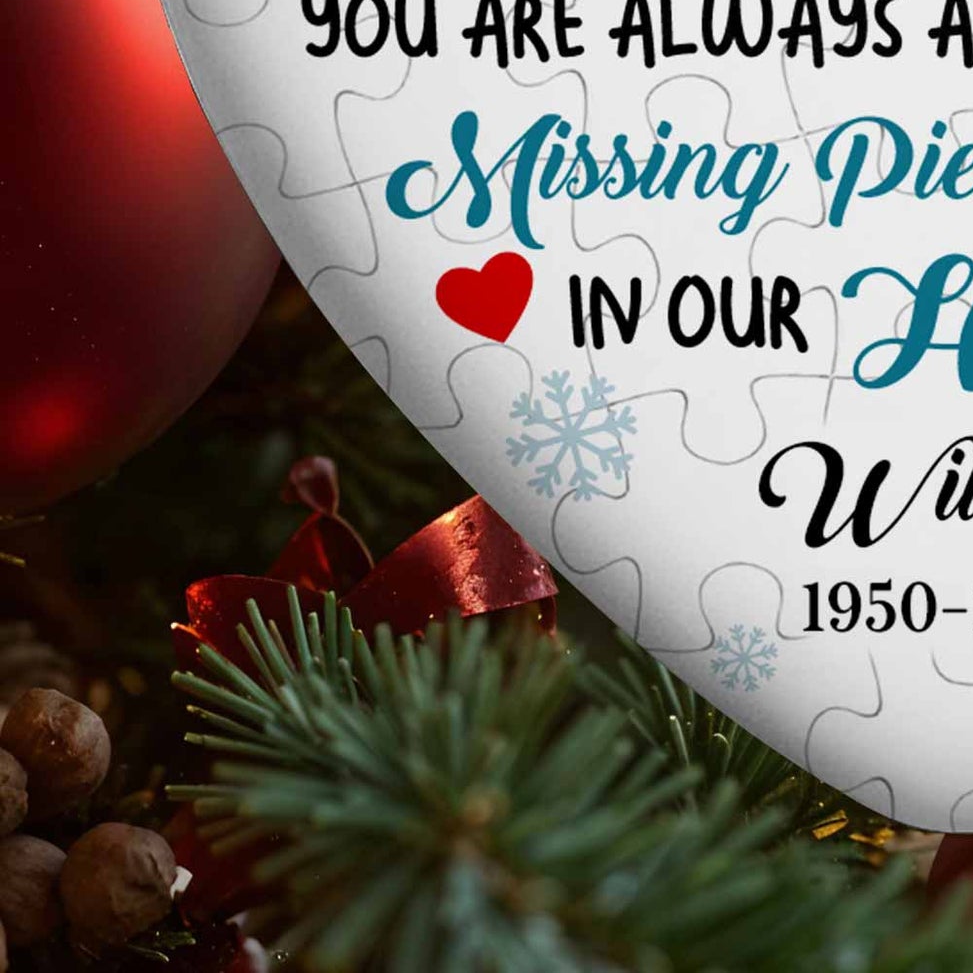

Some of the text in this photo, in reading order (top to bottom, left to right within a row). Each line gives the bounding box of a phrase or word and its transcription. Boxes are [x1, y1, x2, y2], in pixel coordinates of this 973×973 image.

[386, 112, 790, 250] Missing
[570, 275, 642, 350] IN
[668, 275, 809, 354] OUR
